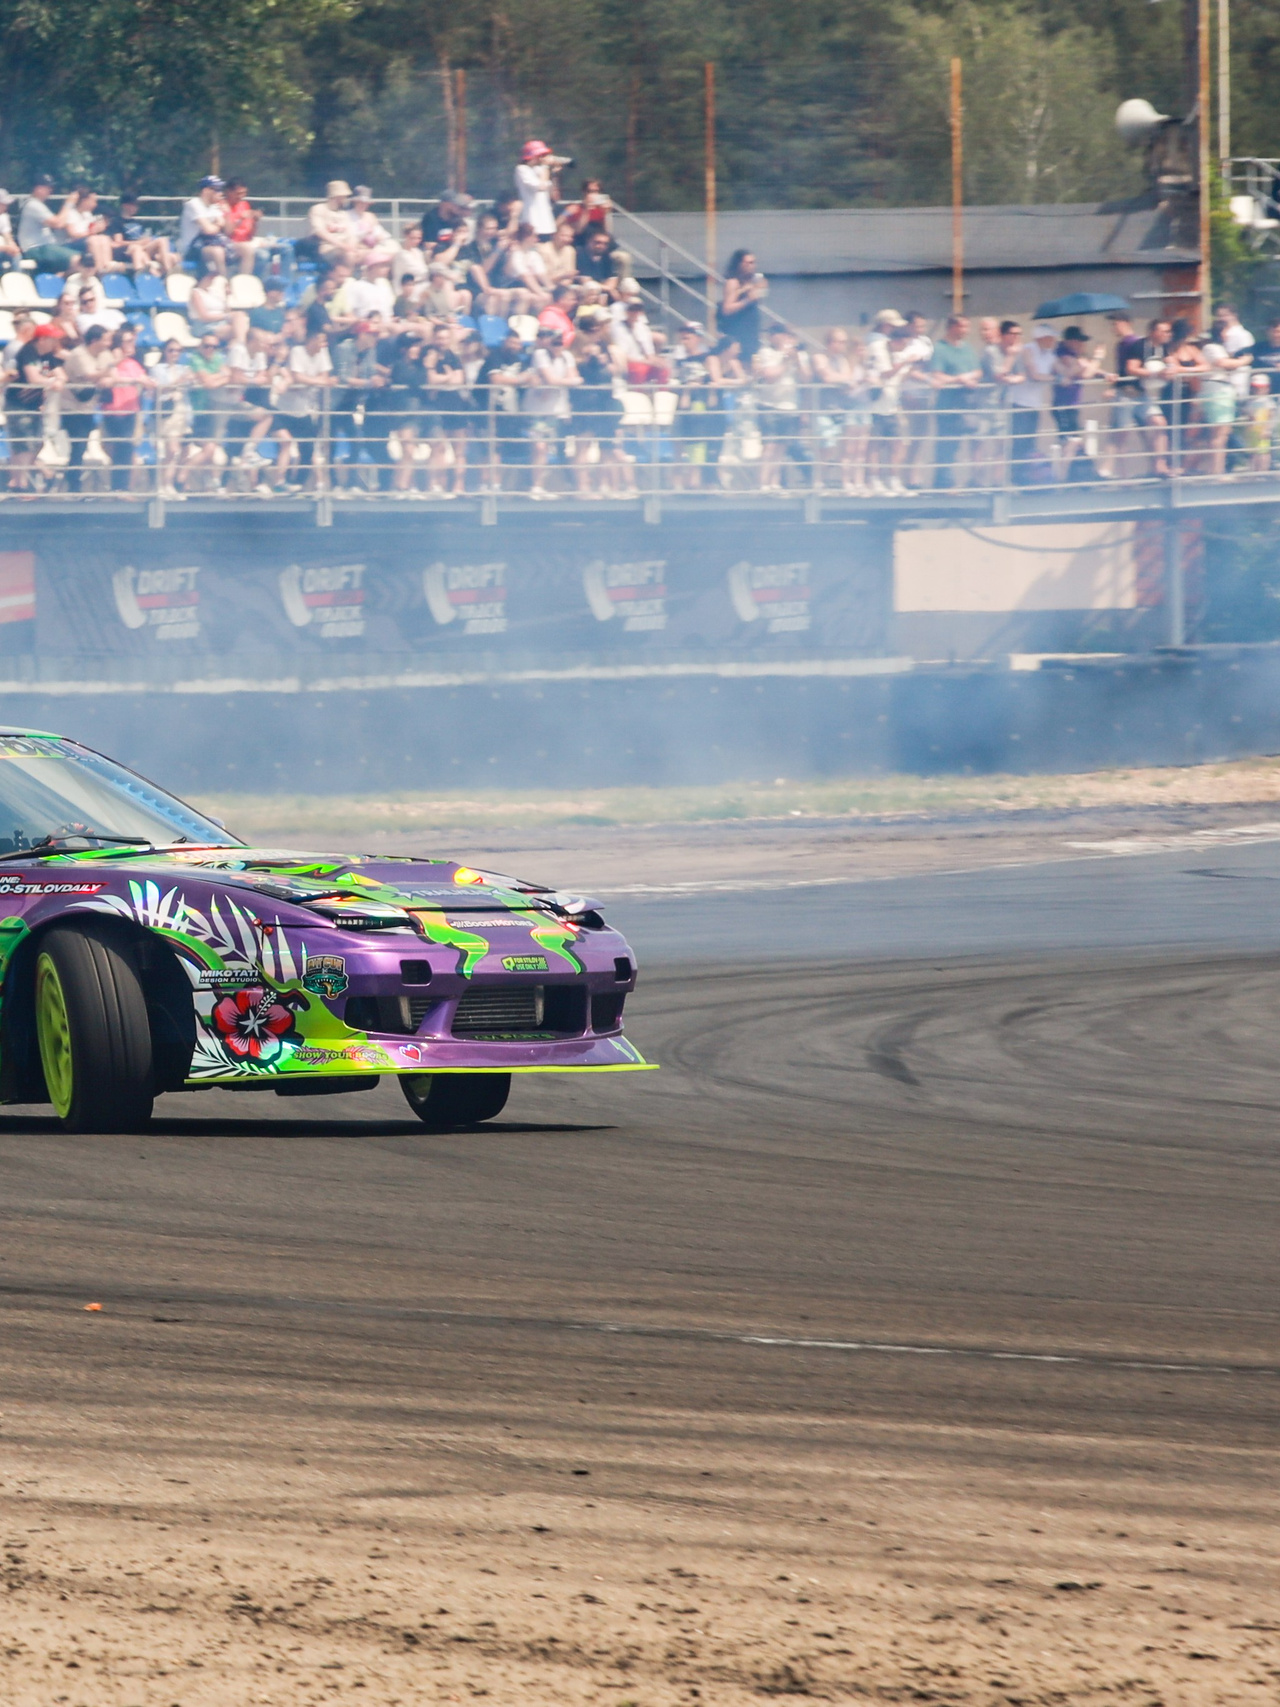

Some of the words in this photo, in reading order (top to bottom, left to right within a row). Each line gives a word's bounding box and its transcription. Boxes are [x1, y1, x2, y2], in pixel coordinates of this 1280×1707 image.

[138, 566, 200, 594] DRIFT
[447, 563, 507, 590] DRIFT
[607, 560, 668, 586] DRIFT
[751, 562, 812, 587] DRIFT
[200, 969, 259, 978] MIKOTATI
[294, 1051, 322, 1059] SHOW
[324, 1051, 354, 1059] YOUR
